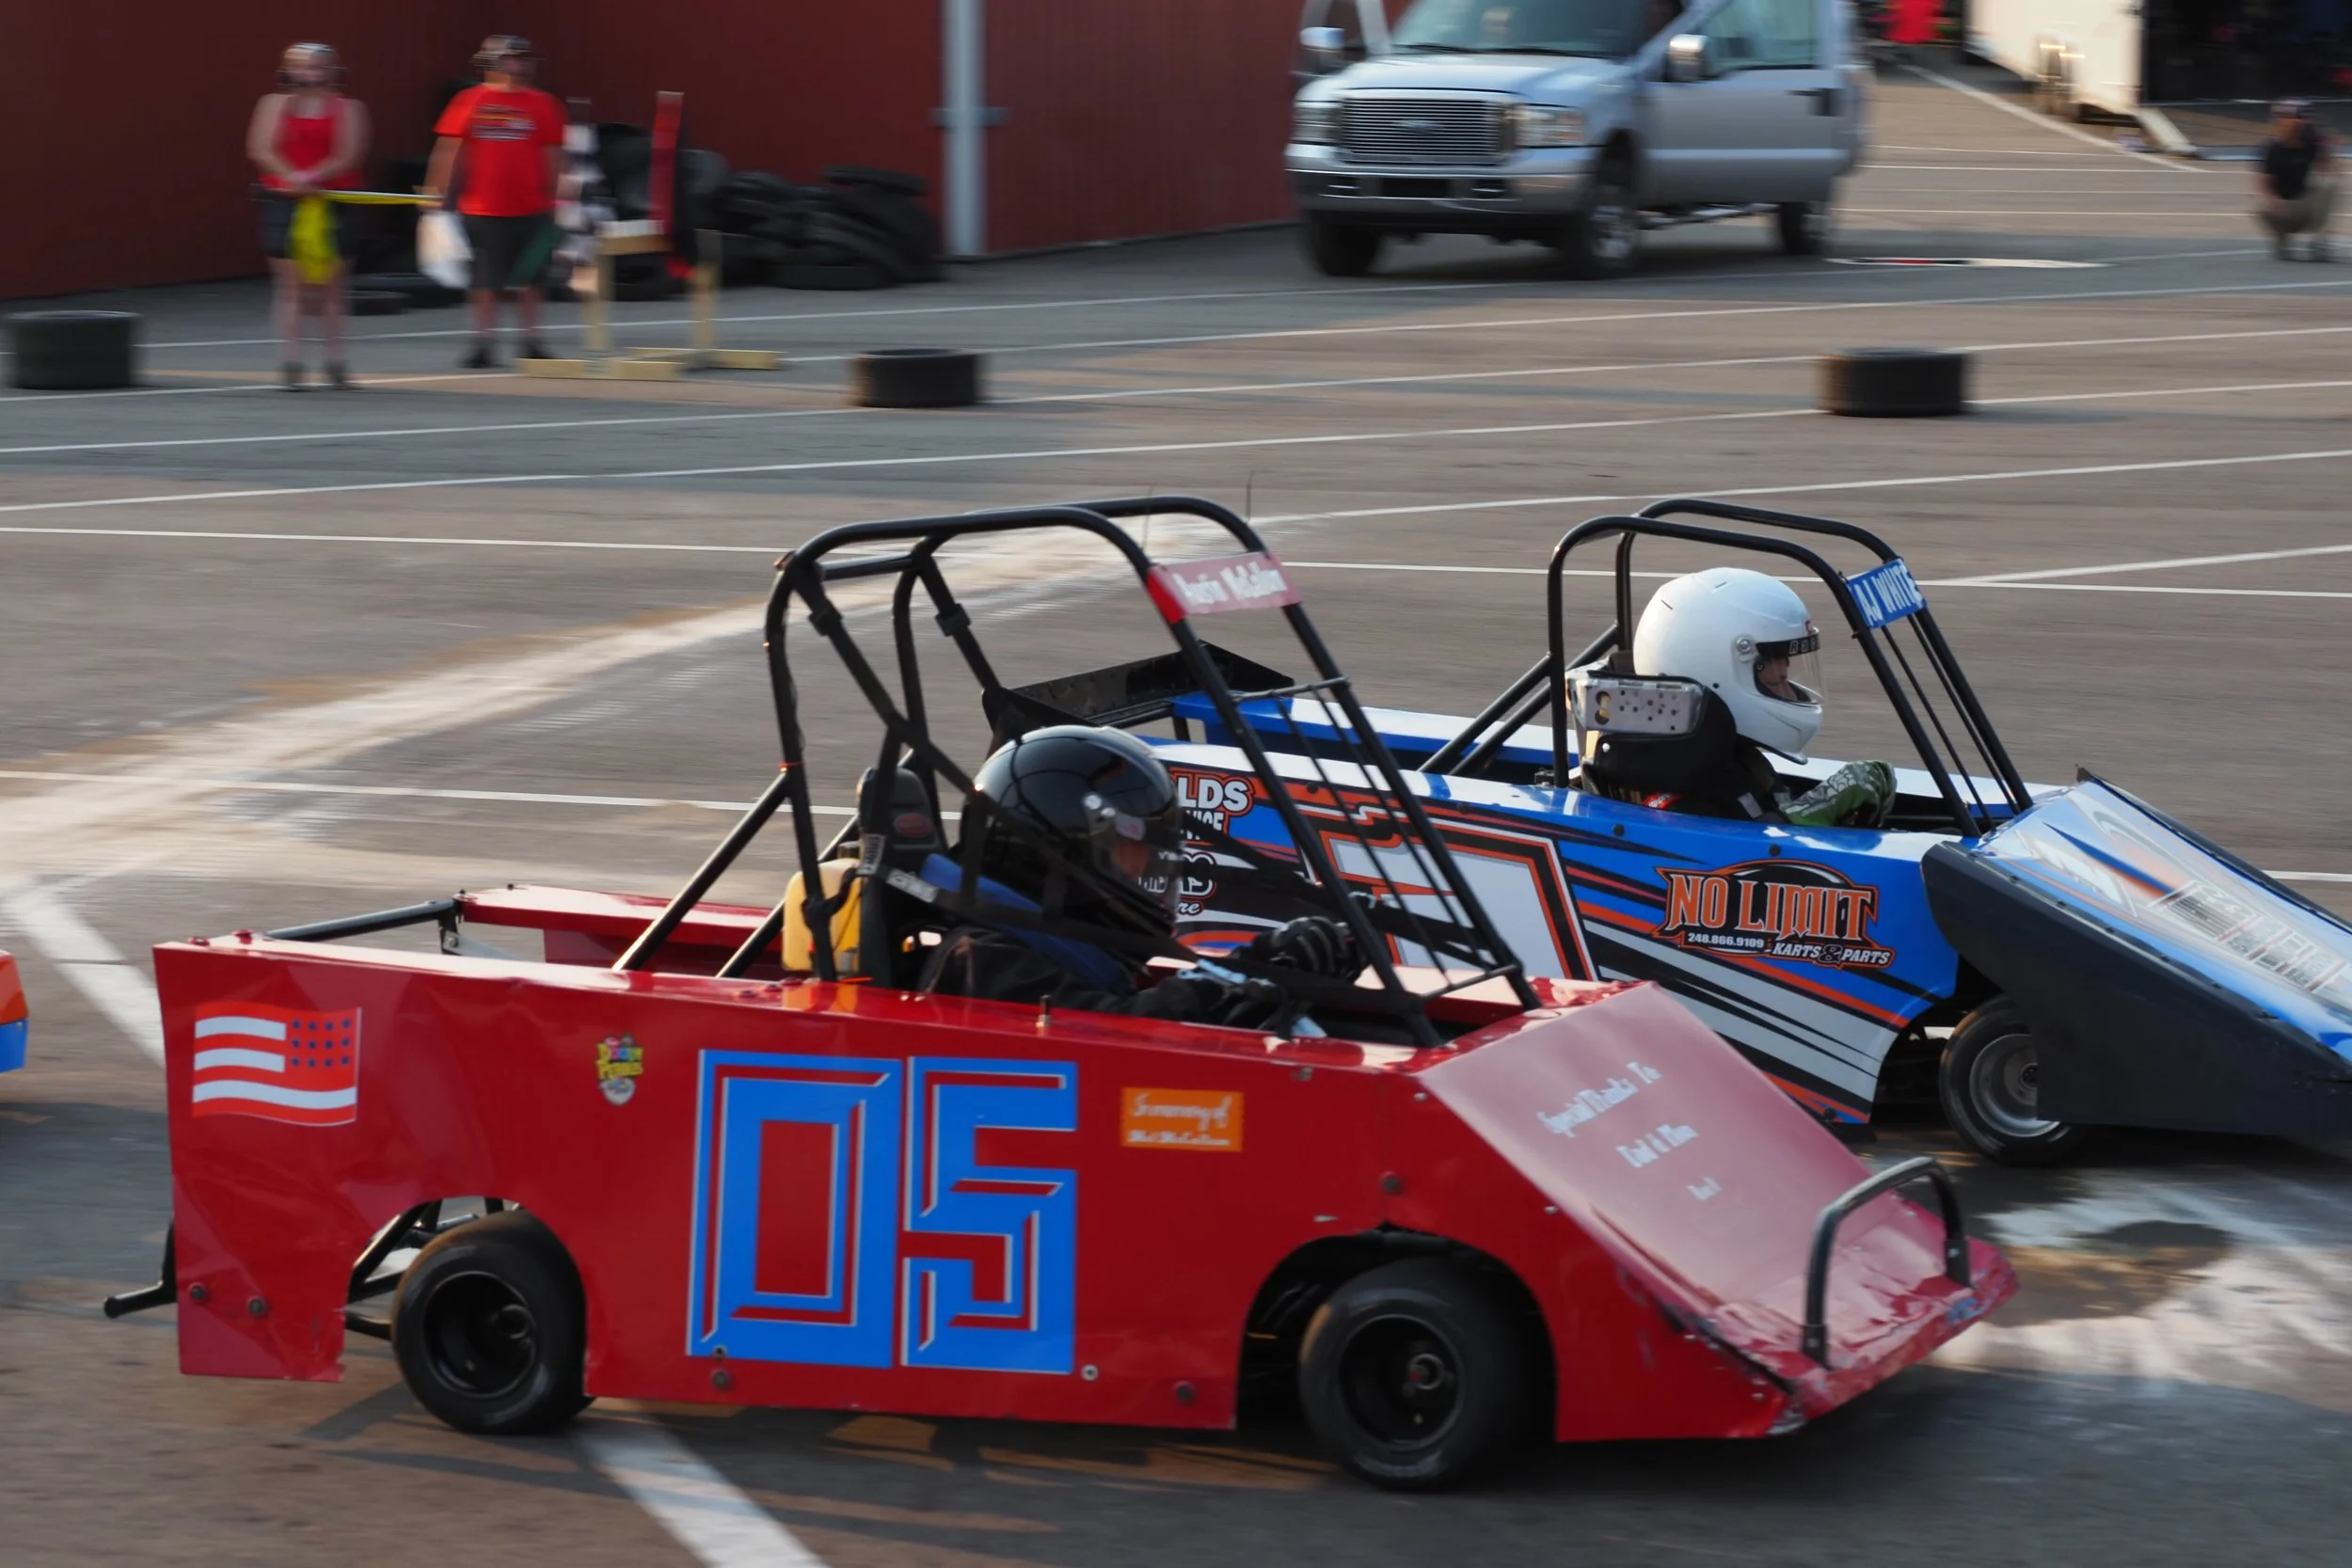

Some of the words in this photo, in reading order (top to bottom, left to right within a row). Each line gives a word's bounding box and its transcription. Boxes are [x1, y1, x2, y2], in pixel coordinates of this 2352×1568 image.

[1853, 579, 1883, 626] AJ
[1665, 873, 1729, 931] NO
[1734, 879, 1872, 941] LIMIT
[1771, 942, 1820, 958] KARTS
[1840, 948, 1891, 965] PARTS
